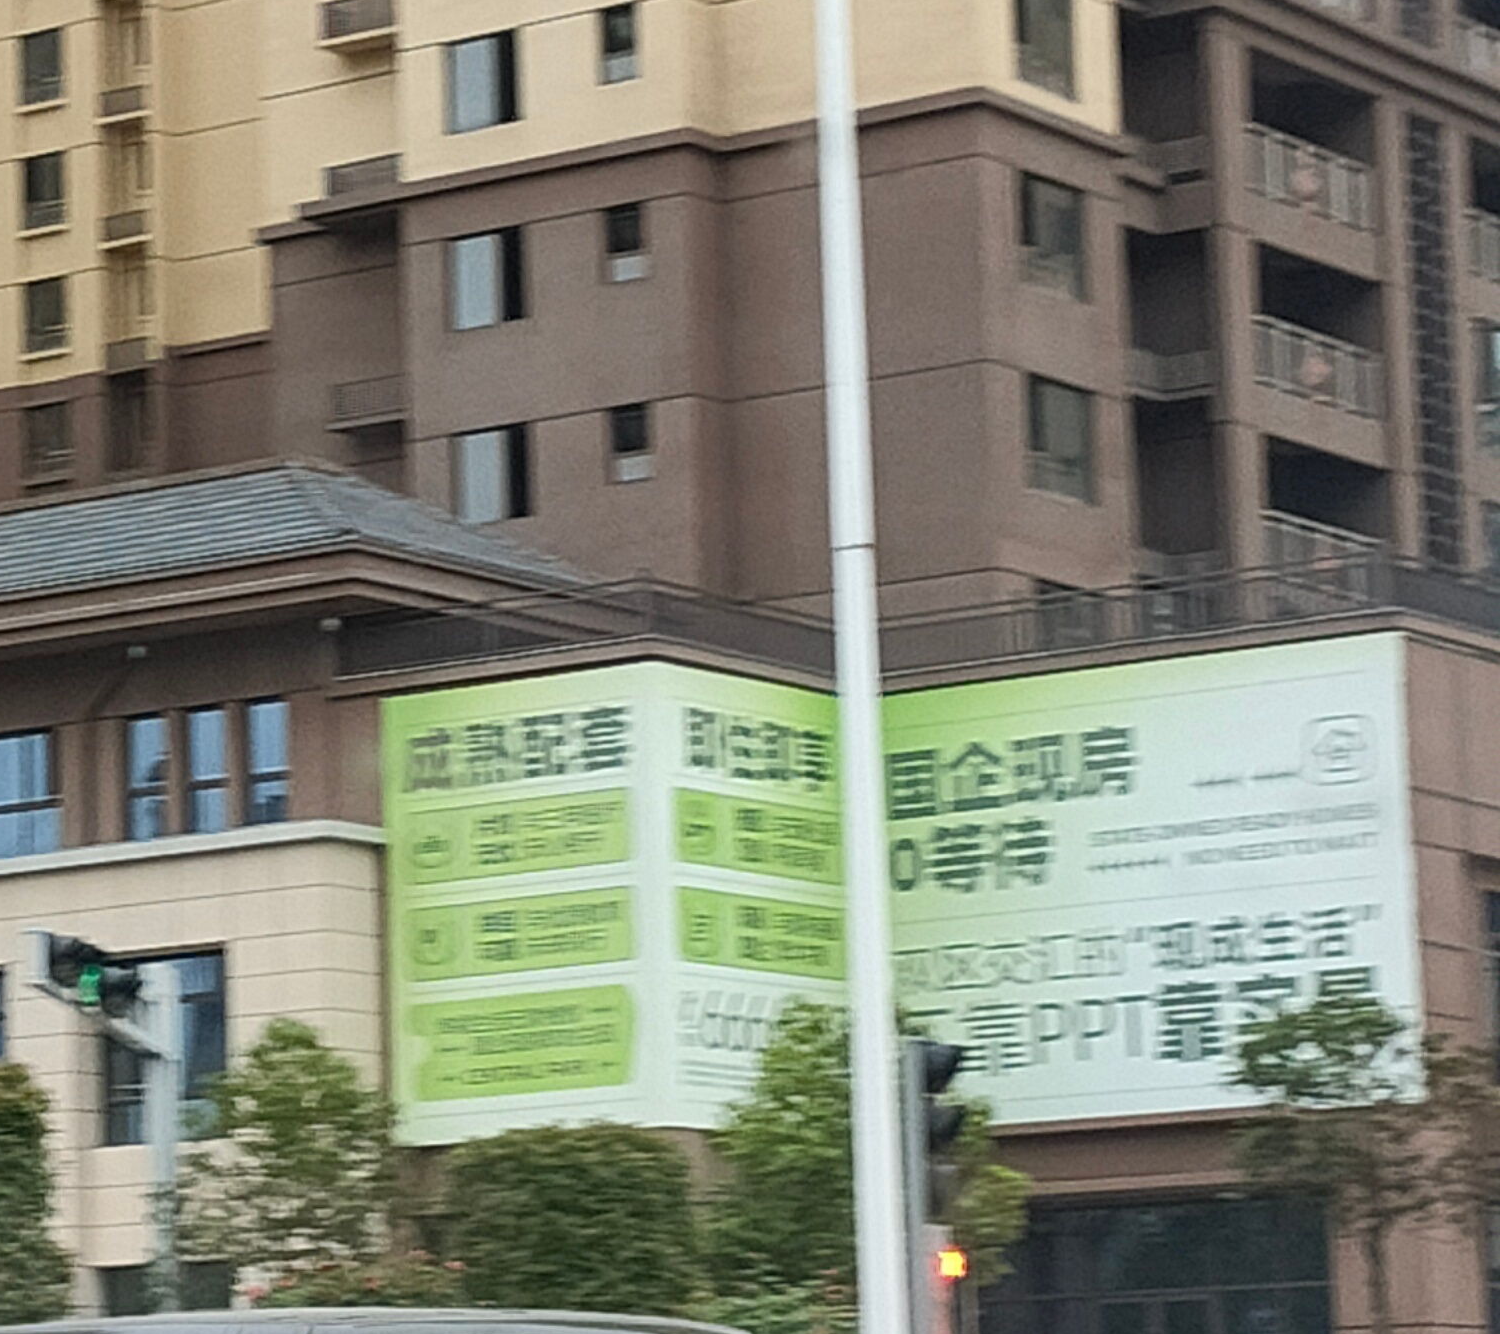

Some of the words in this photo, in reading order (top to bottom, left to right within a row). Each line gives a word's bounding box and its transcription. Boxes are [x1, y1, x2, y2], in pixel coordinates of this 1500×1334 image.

[404, 704, 631, 794] 成熟配套
[886, 724, 1136, 821] 国企现房
[890, 817, 1050, 893] 0等待
